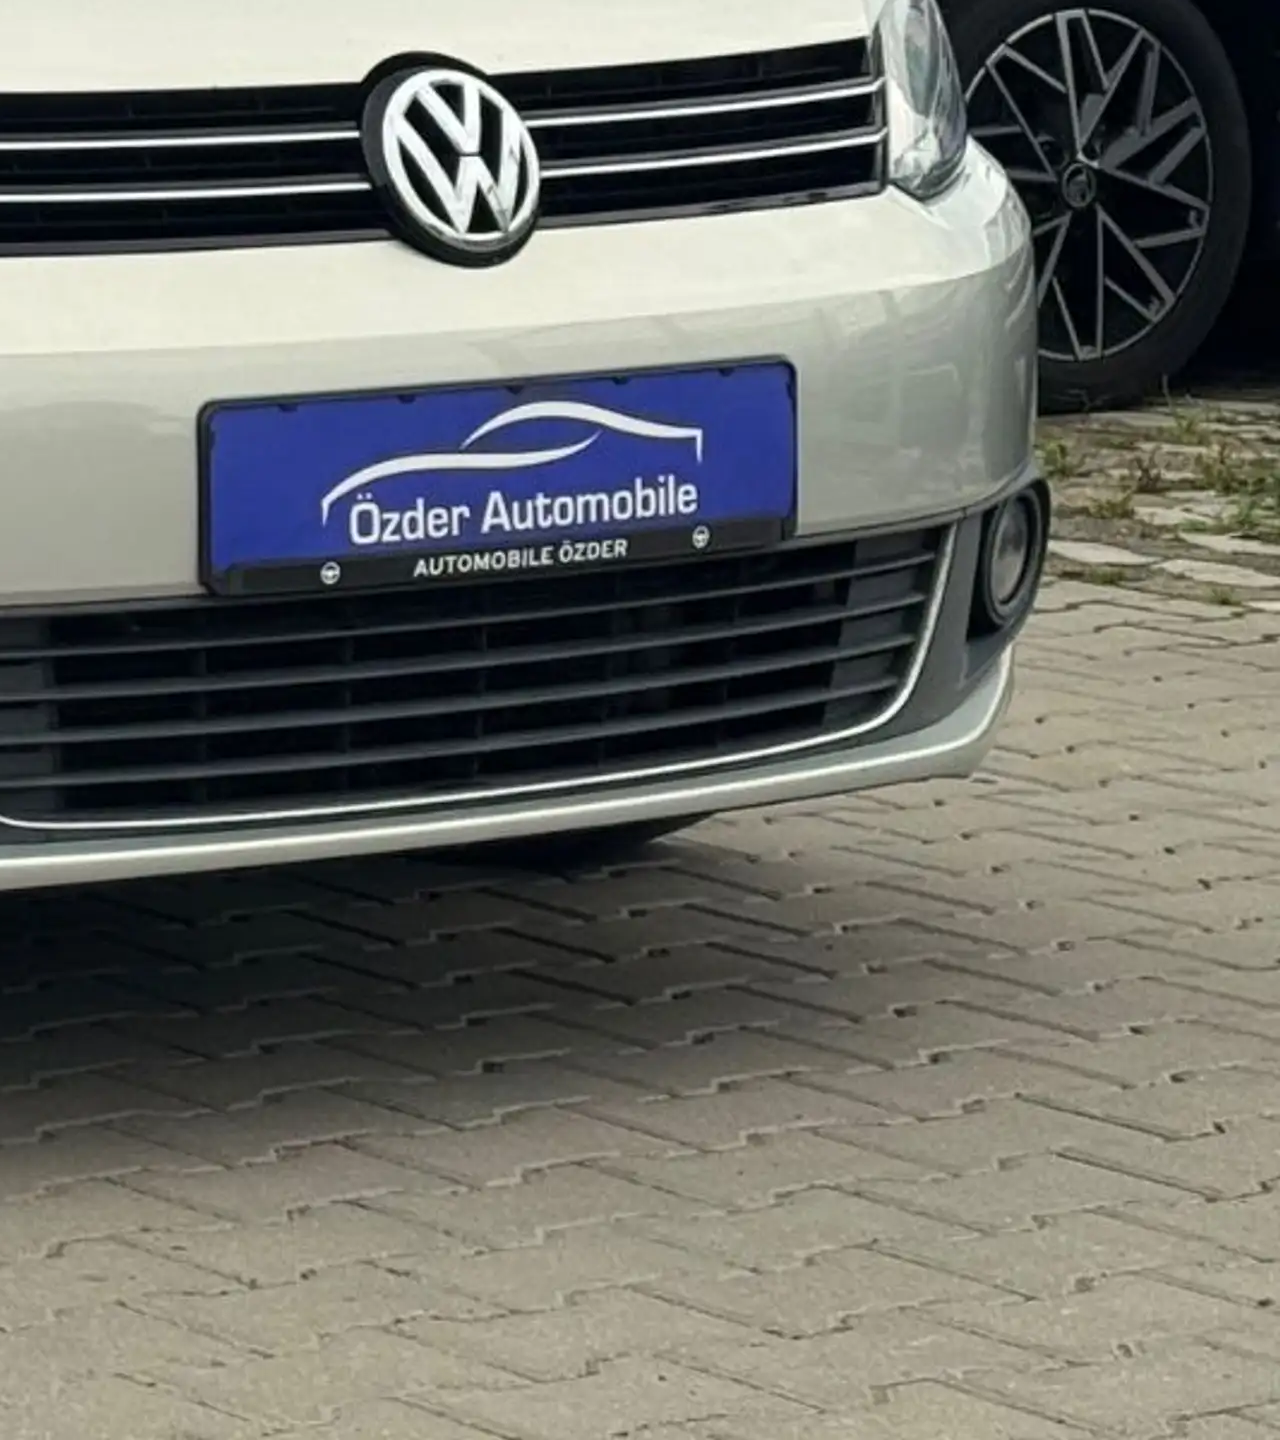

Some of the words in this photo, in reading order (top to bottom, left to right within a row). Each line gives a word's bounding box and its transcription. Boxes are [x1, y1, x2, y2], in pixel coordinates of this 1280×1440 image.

[349, 493, 471, 546] Özder
[480, 474, 700, 535] Automobile
[413, 544, 555, 578] AUTOMOBILE
[558, 537, 628, 563] ÖZDER
